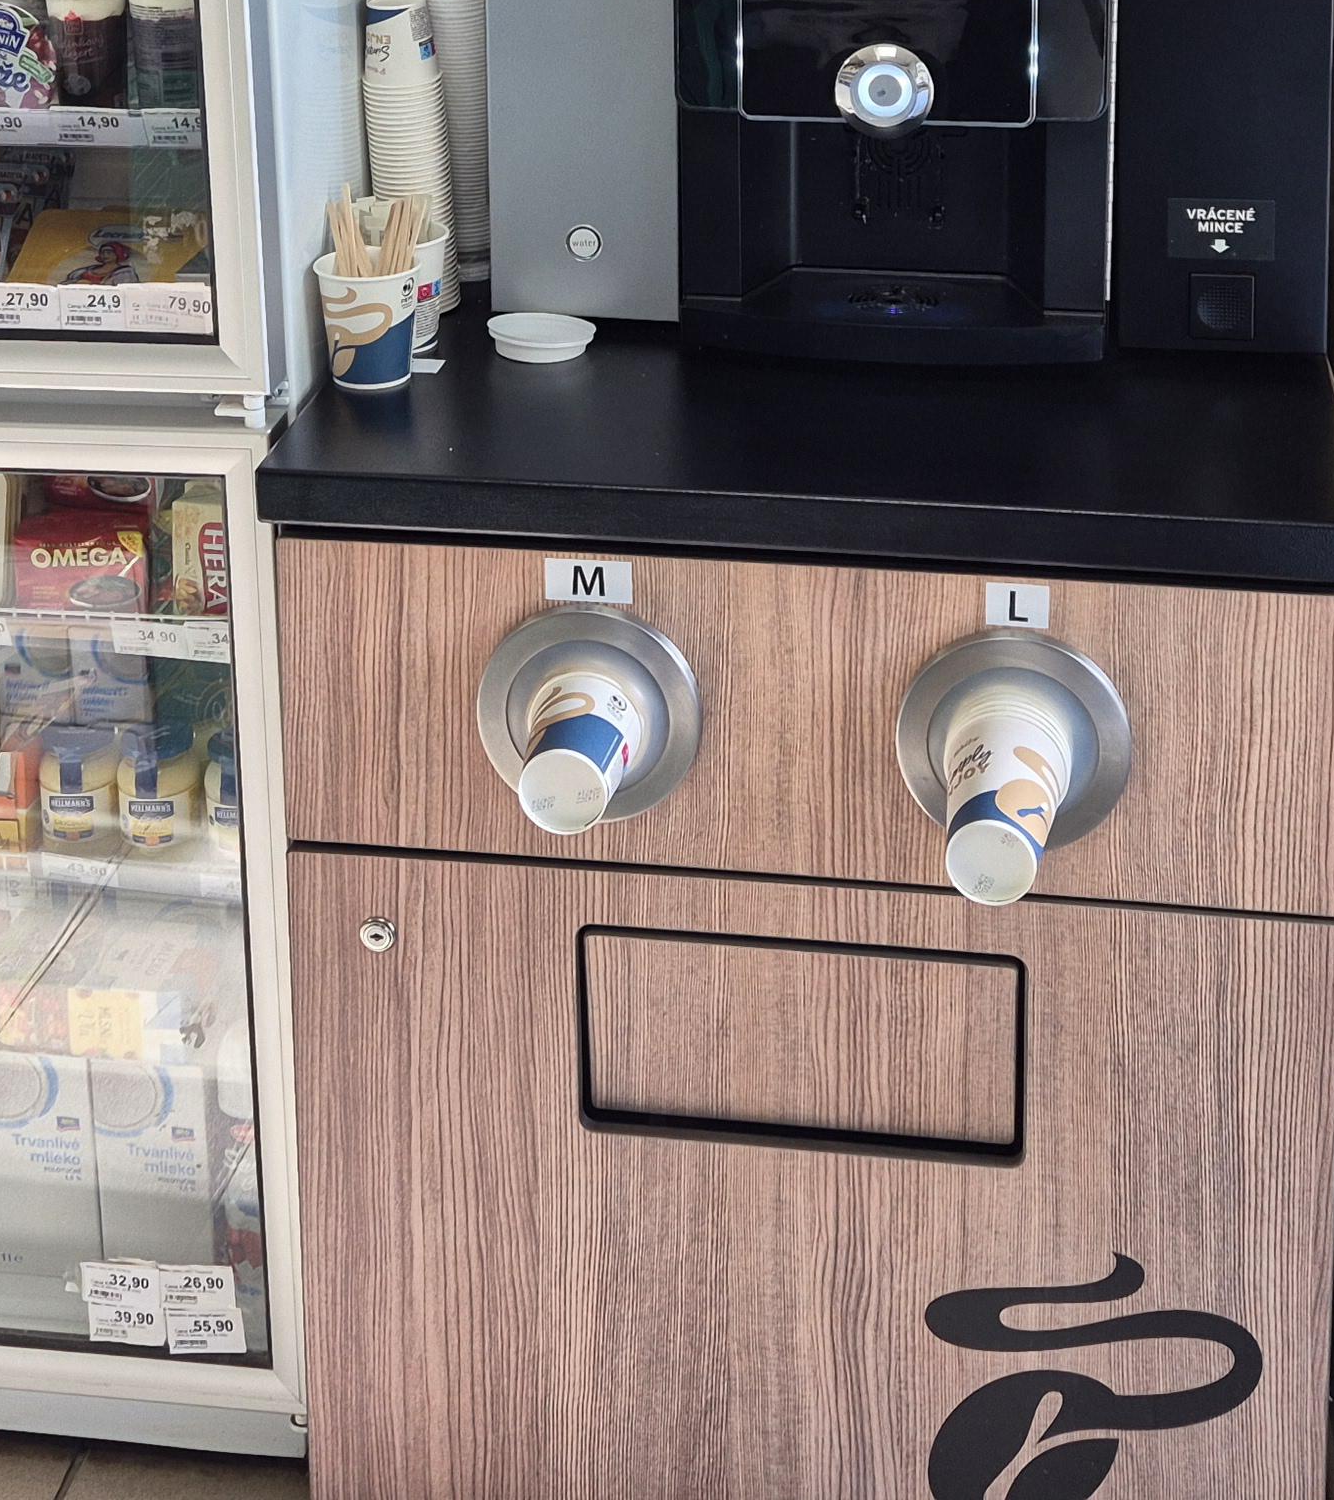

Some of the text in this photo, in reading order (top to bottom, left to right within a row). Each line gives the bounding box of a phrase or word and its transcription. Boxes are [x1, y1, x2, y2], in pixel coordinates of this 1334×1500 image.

[77, 116, 119, 129] 14,90
[171, 117, 201, 131] 14,9
[1186, 206, 1256, 221] VRÁCENÉ
[1197, 222, 1244, 233] MINCE
[571, 239, 596, 248] water
[6, 292, 48, 308] 27,90
[87, 294, 120, 310] 24,9
[168, 296, 211, 315] 79,90
[30, 547, 128, 568] OMEGA
[203, 525, 228, 607] HERA
[572, 566, 606, 597] M
[1008, 591, 1028, 623] L
[12, 1133, 80, 1151] Trvanlivé
[29, 1150, 81, 1167] mlieko
[127, 1142, 195, 1162] Trvanlivé
[110, 1274, 149, 1291] 32,90
[184, 1276, 223, 1292] 26,90
[115, 1311, 154, 1327] 39,90
[194, 1320, 233, 1335] 55,90
